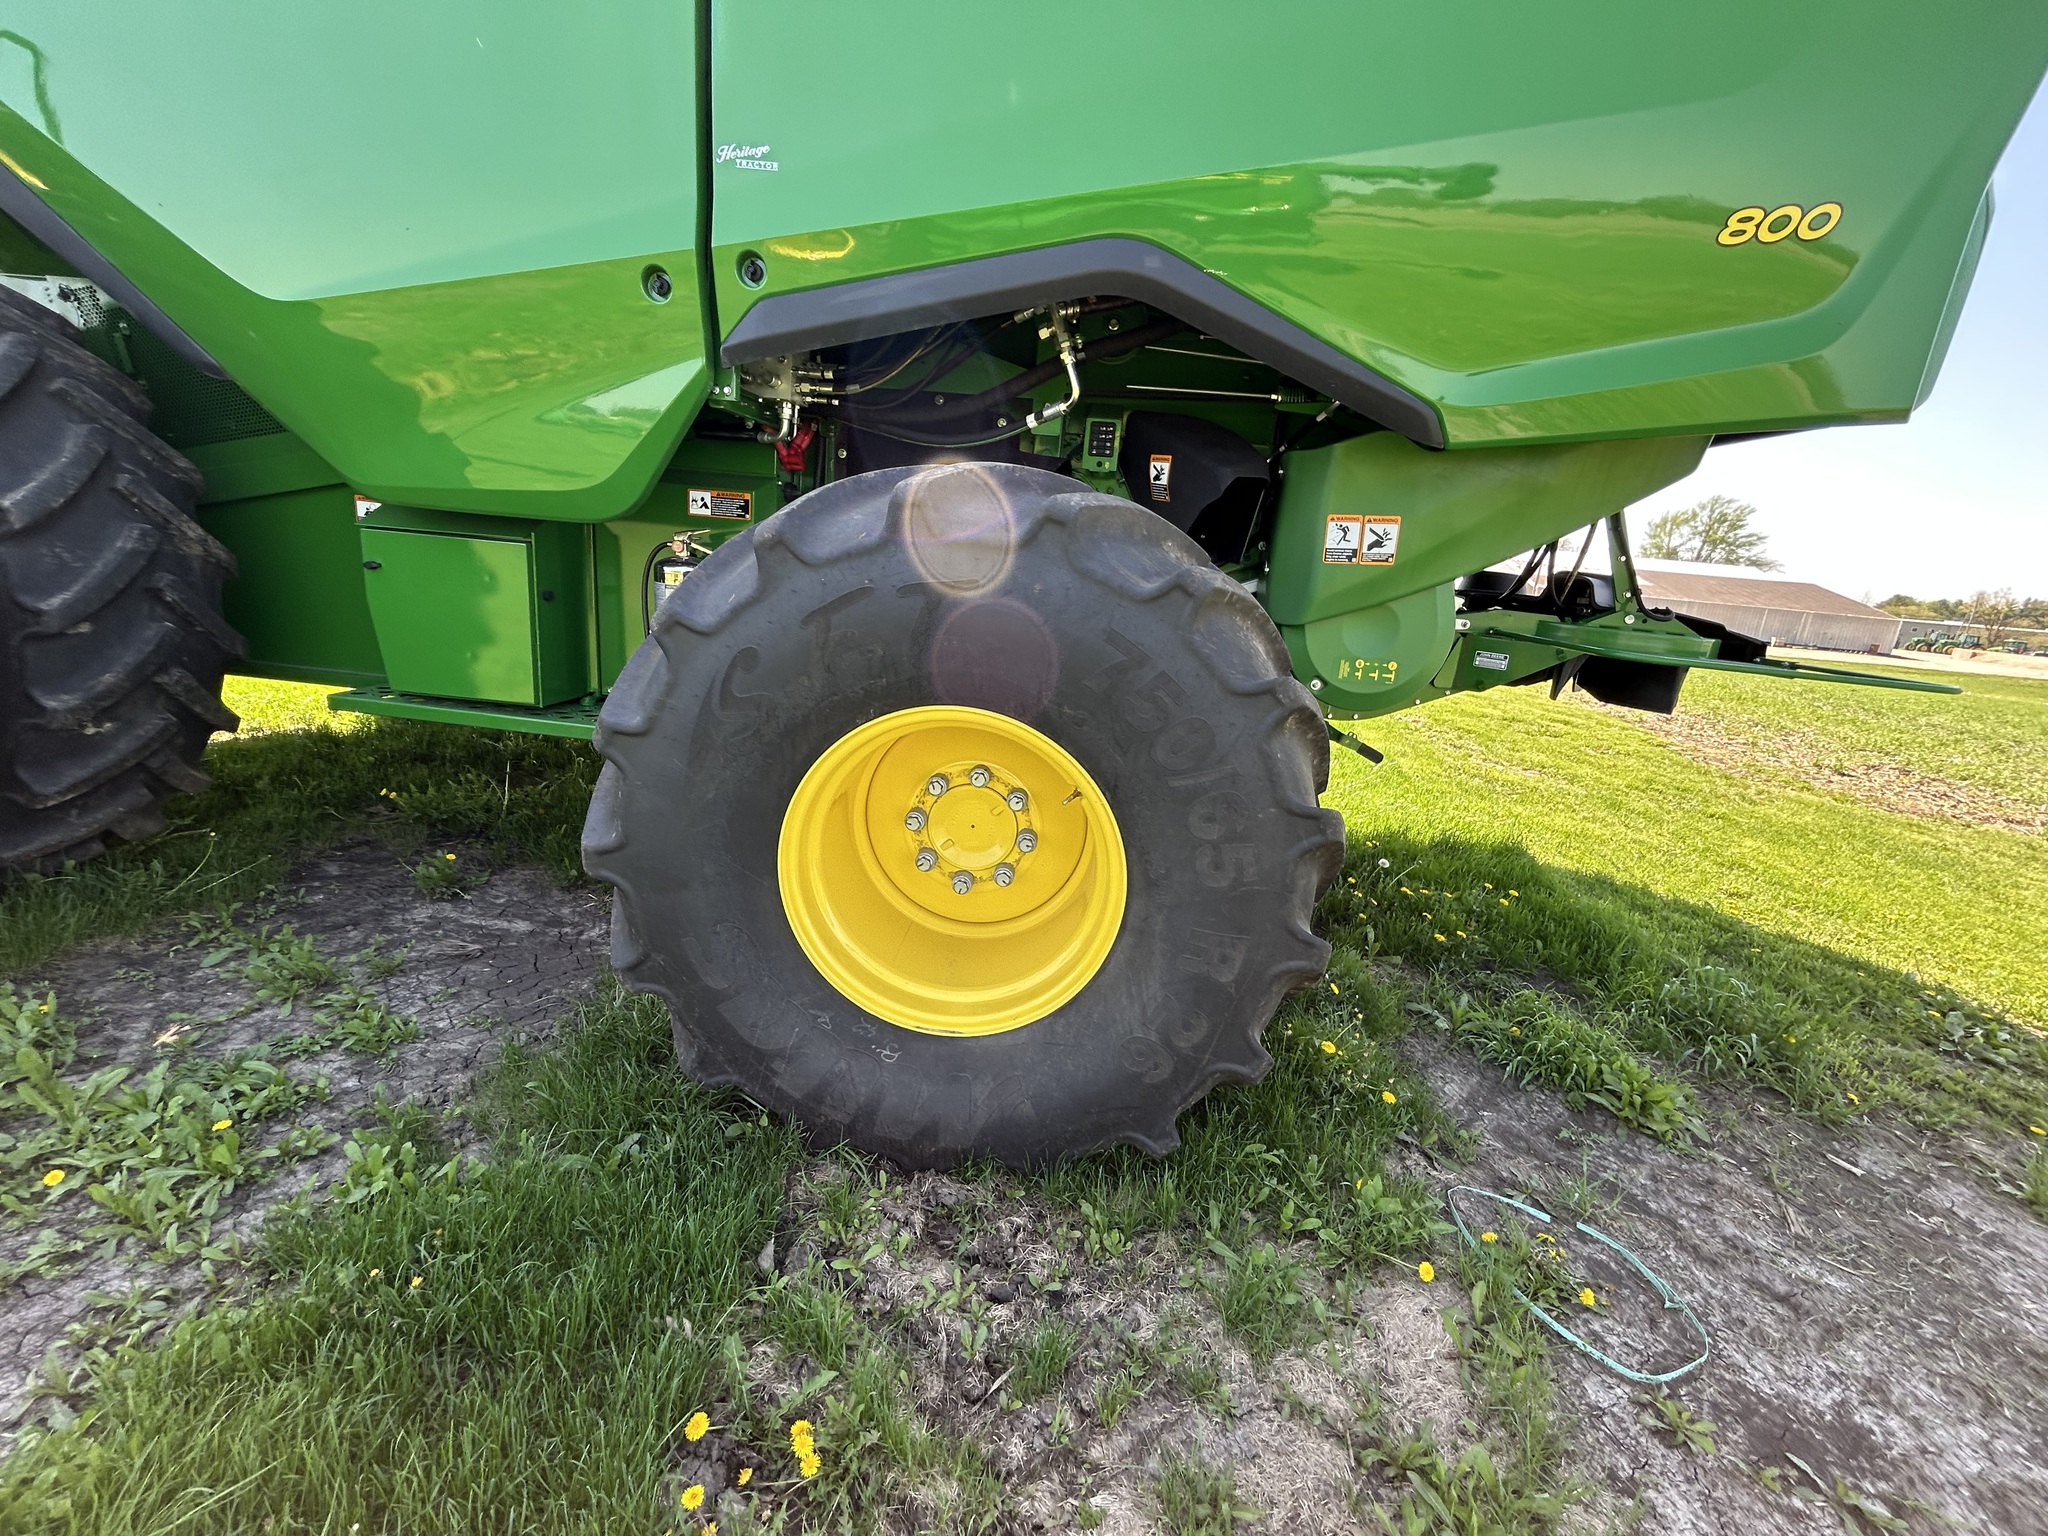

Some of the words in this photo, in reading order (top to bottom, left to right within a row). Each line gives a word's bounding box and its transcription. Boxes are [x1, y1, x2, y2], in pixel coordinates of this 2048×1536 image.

[716, 143, 771, 163] Heritage
[735, 159, 778, 171] TRACTOR
[1716, 201, 1844, 247] 800
